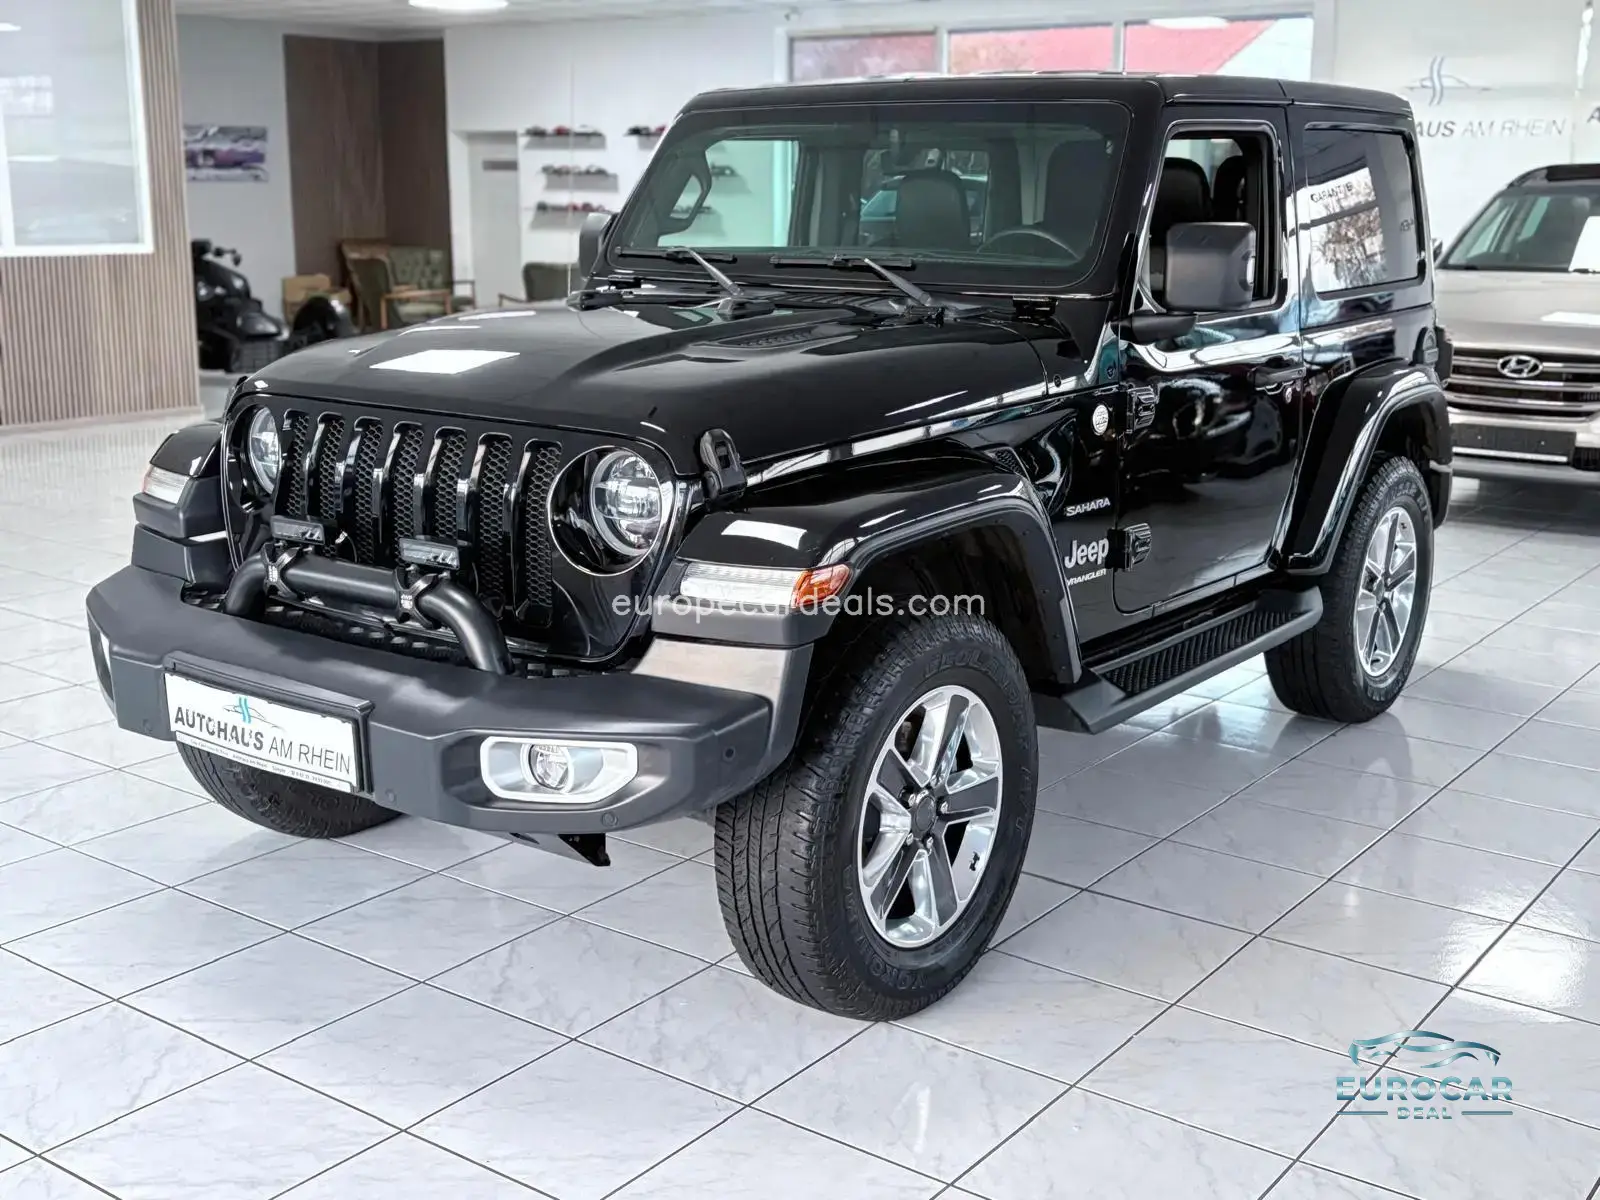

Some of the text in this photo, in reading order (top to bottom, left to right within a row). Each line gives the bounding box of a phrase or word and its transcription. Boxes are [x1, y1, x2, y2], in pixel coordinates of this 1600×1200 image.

[1461, 119, 1495, 138] AM
[1500, 118, 1567, 138] RHEIN
[1065, 496, 1111, 517] SAHARA
[1064, 537, 1110, 569] Jeep
[174, 706, 264, 751] AUTOHAUS
[268, 736, 293, 760] AM
[298, 743, 351, 775] RHEIN
